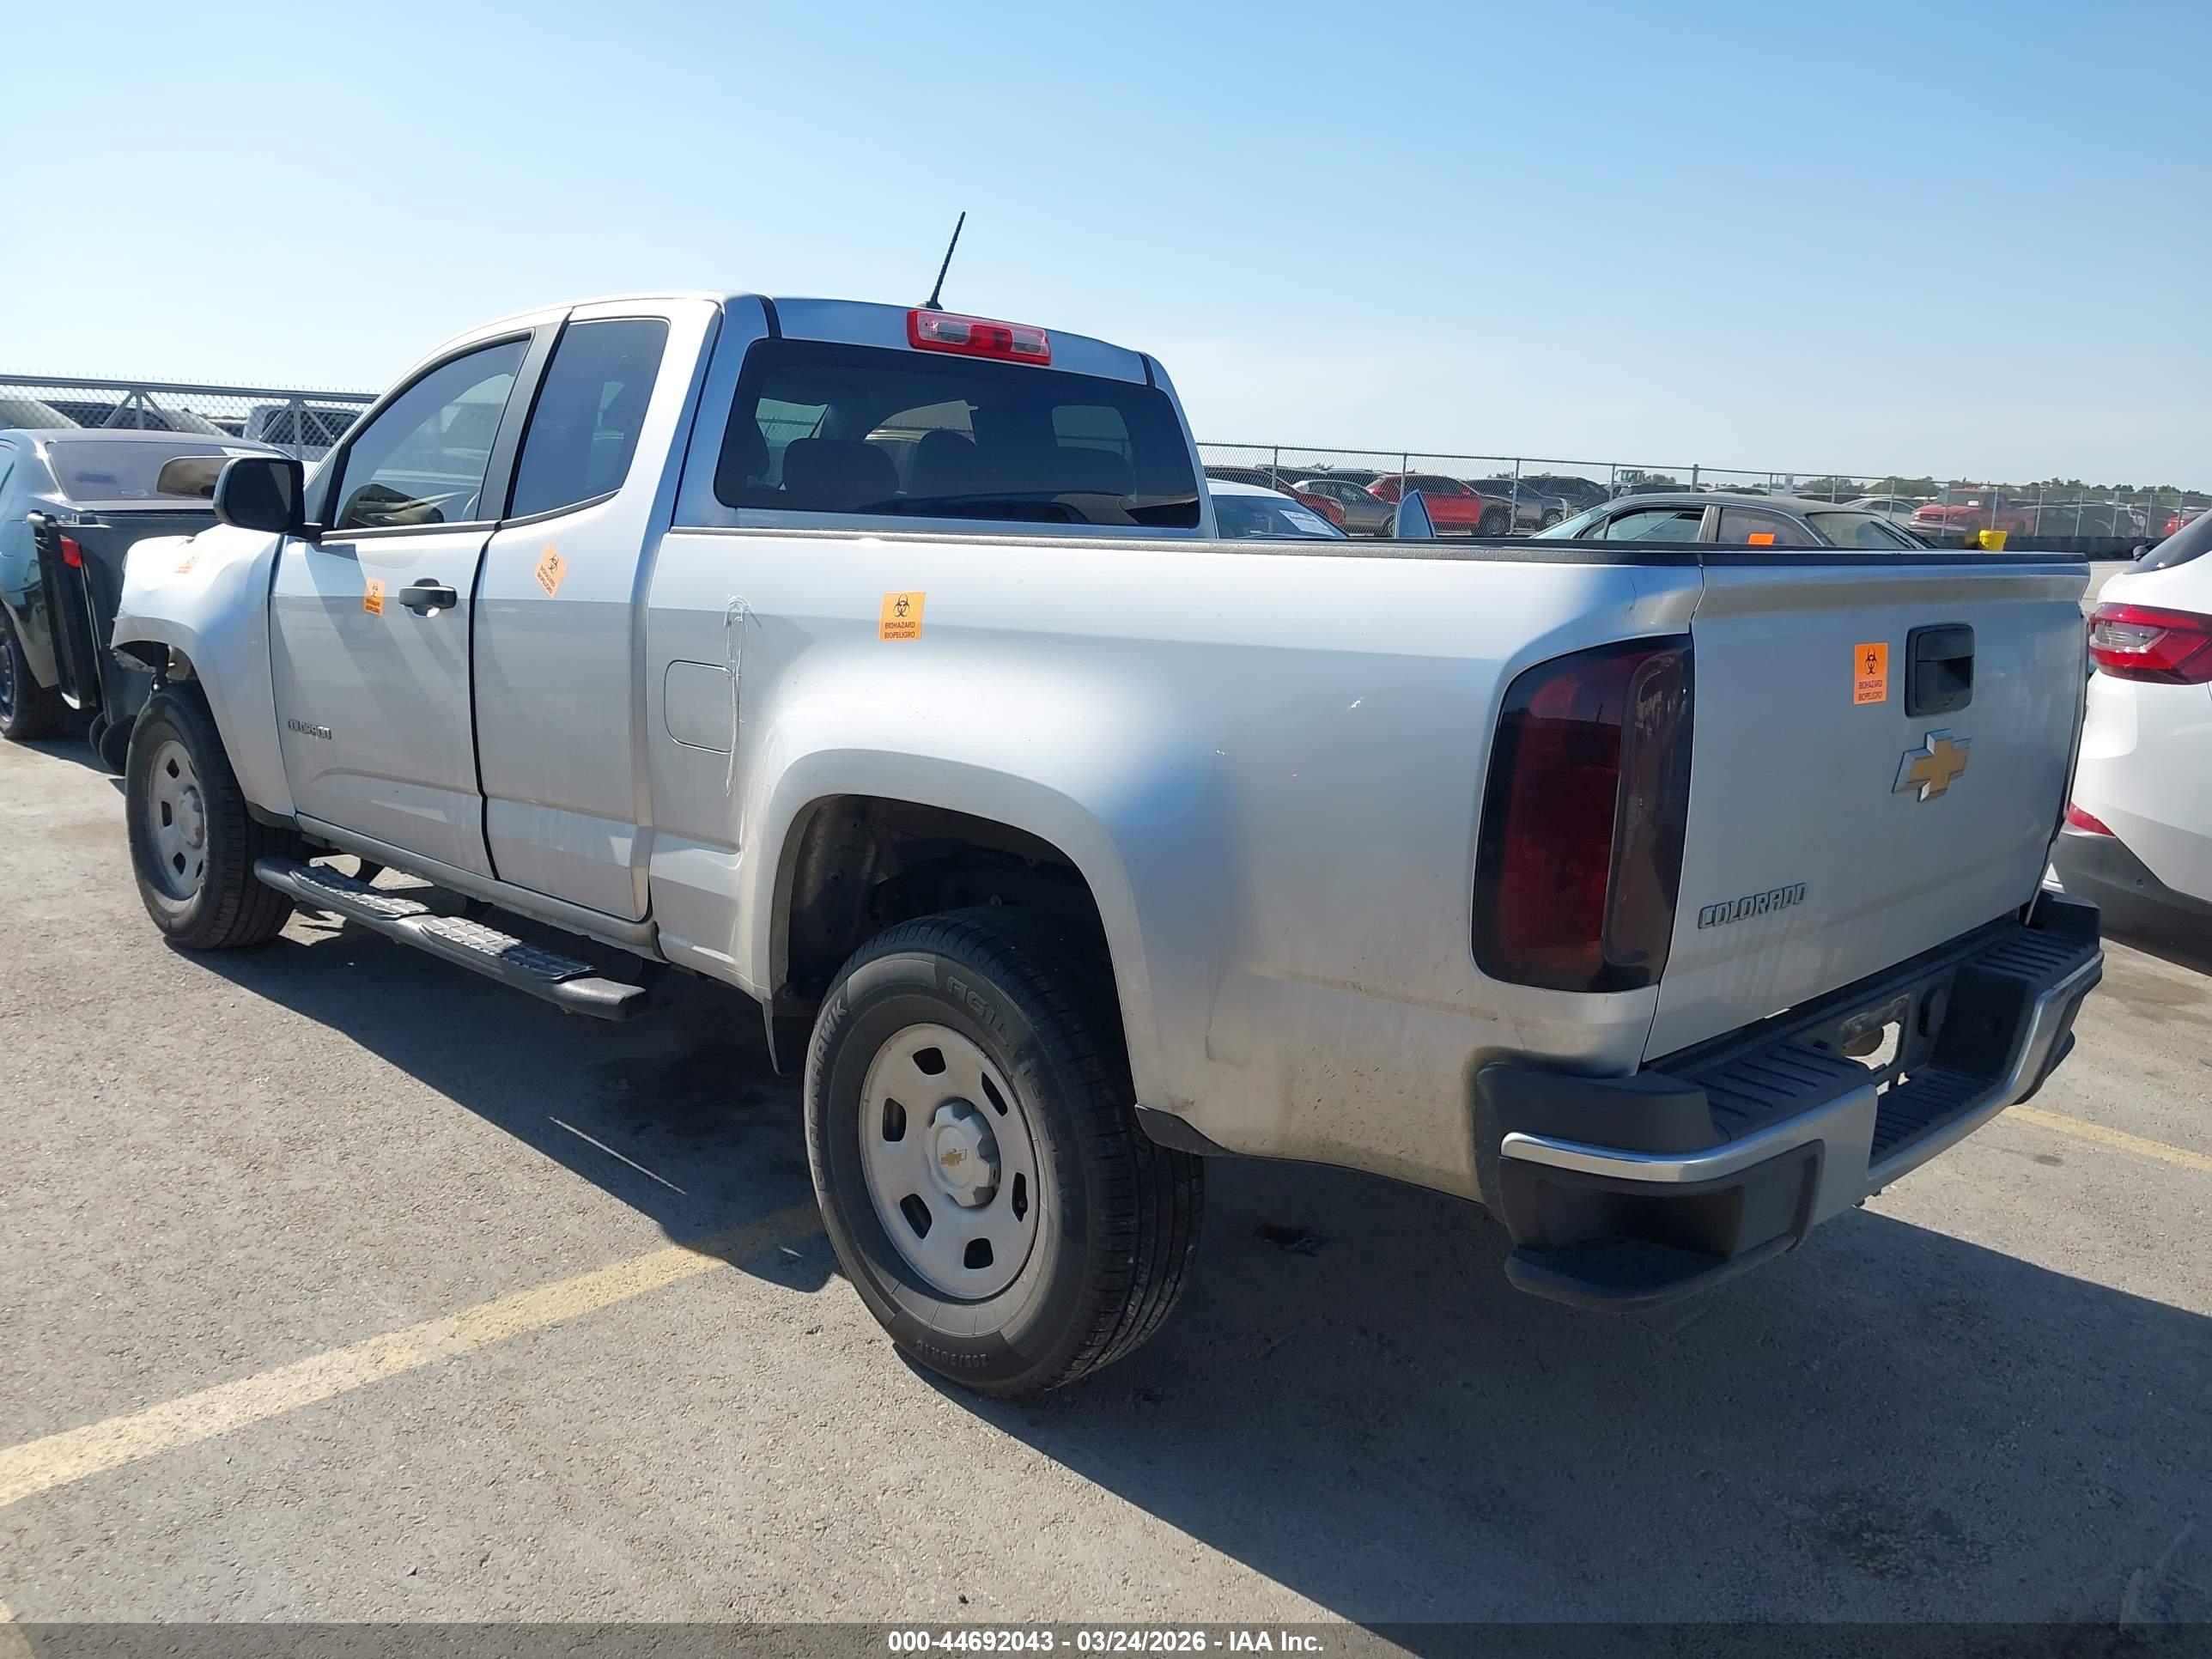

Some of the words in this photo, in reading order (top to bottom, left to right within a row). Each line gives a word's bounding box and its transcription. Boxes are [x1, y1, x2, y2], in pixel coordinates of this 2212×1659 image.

[884, 621, 916, 629] BIOHAZARD
[884, 630, 915, 639] BIOPELIGRO
[1858, 679, 1883, 690] BIOHAZARD
[288, 718, 332, 740] COLORADO
[1698, 882, 1807, 929] COLORADO
[808, 996, 848, 1194] BLACKHAWK
